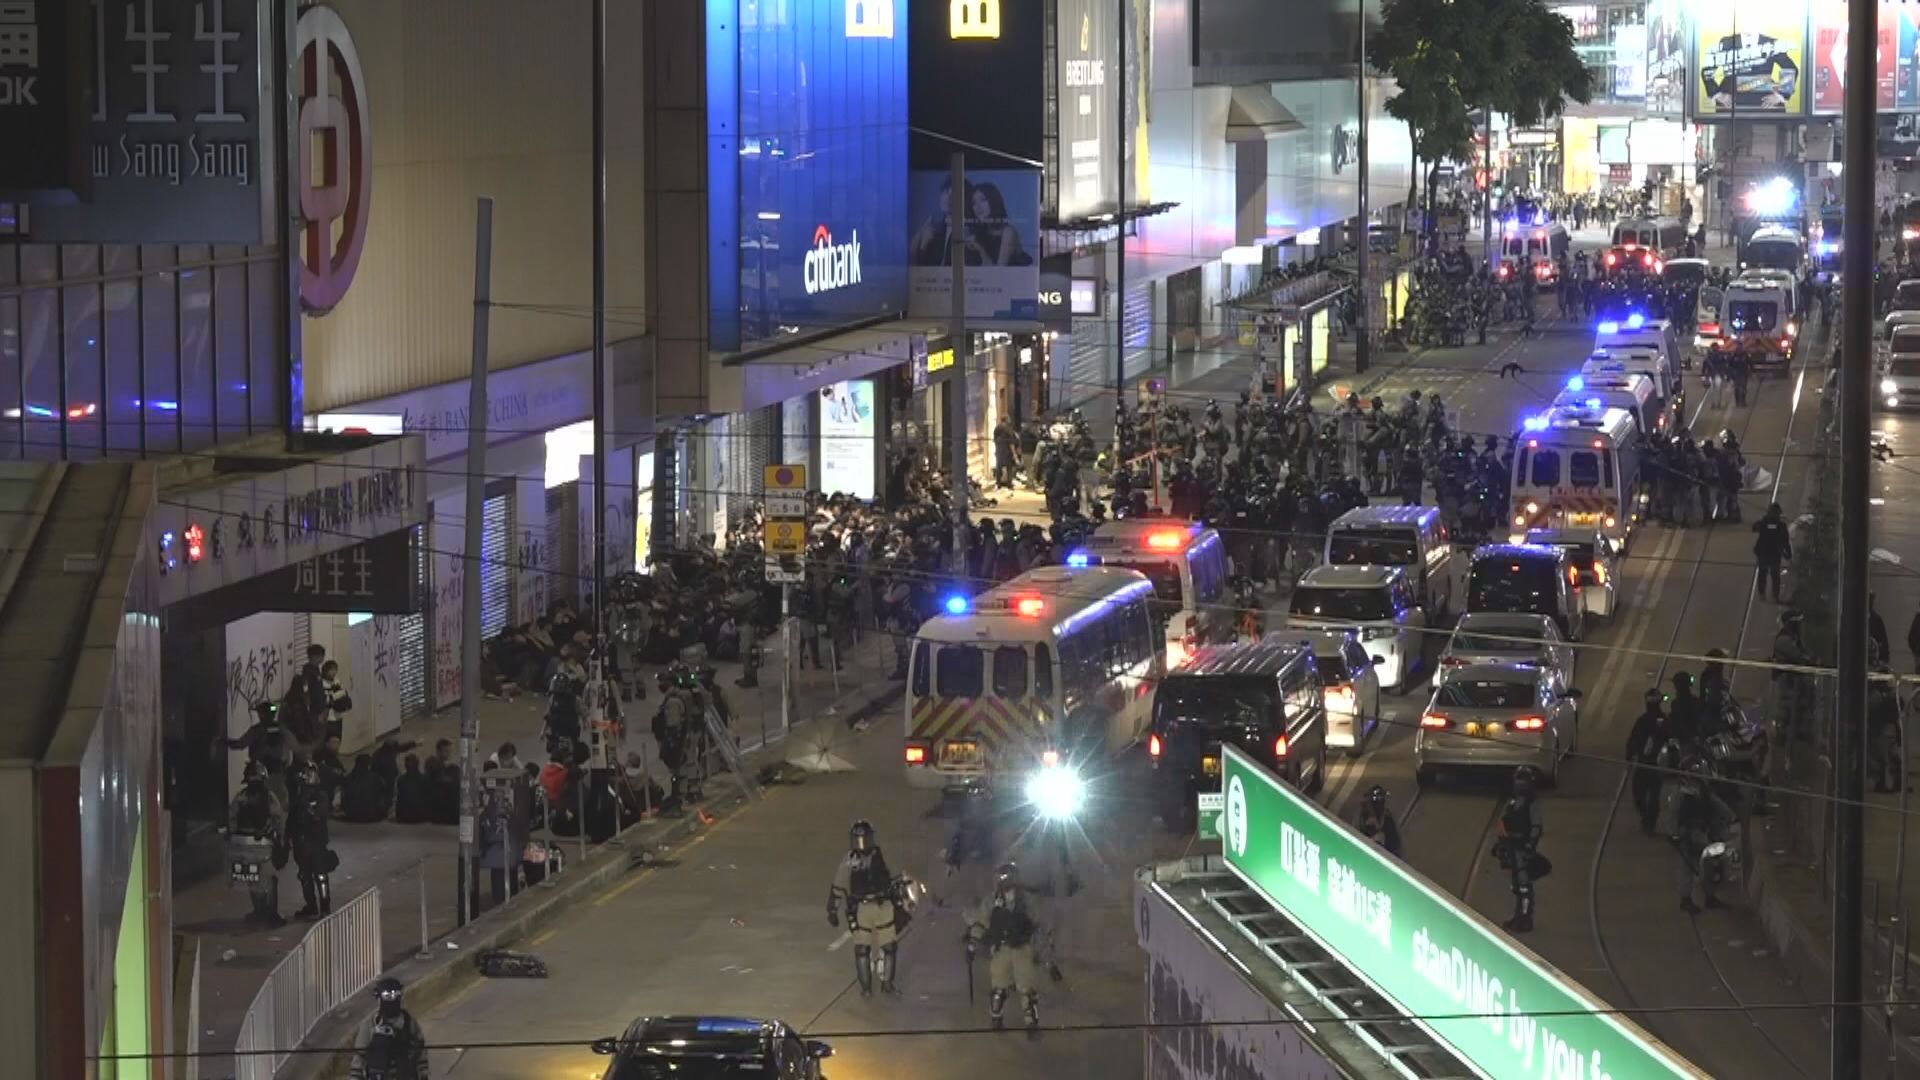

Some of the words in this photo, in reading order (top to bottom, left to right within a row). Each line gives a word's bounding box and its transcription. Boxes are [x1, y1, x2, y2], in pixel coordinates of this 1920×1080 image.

[1066, 60, 1104, 86] BREITLING
[120, 133, 180, 185] Sang
[189, 133, 248, 185] Sang
[804, 226, 861, 294] citibank
[444, 404, 470, 435] BAN
[494, 394, 529, 424] CHINA
[1412, 926, 1505, 1036] stanDING
[1508, 988, 1537, 1072] by
